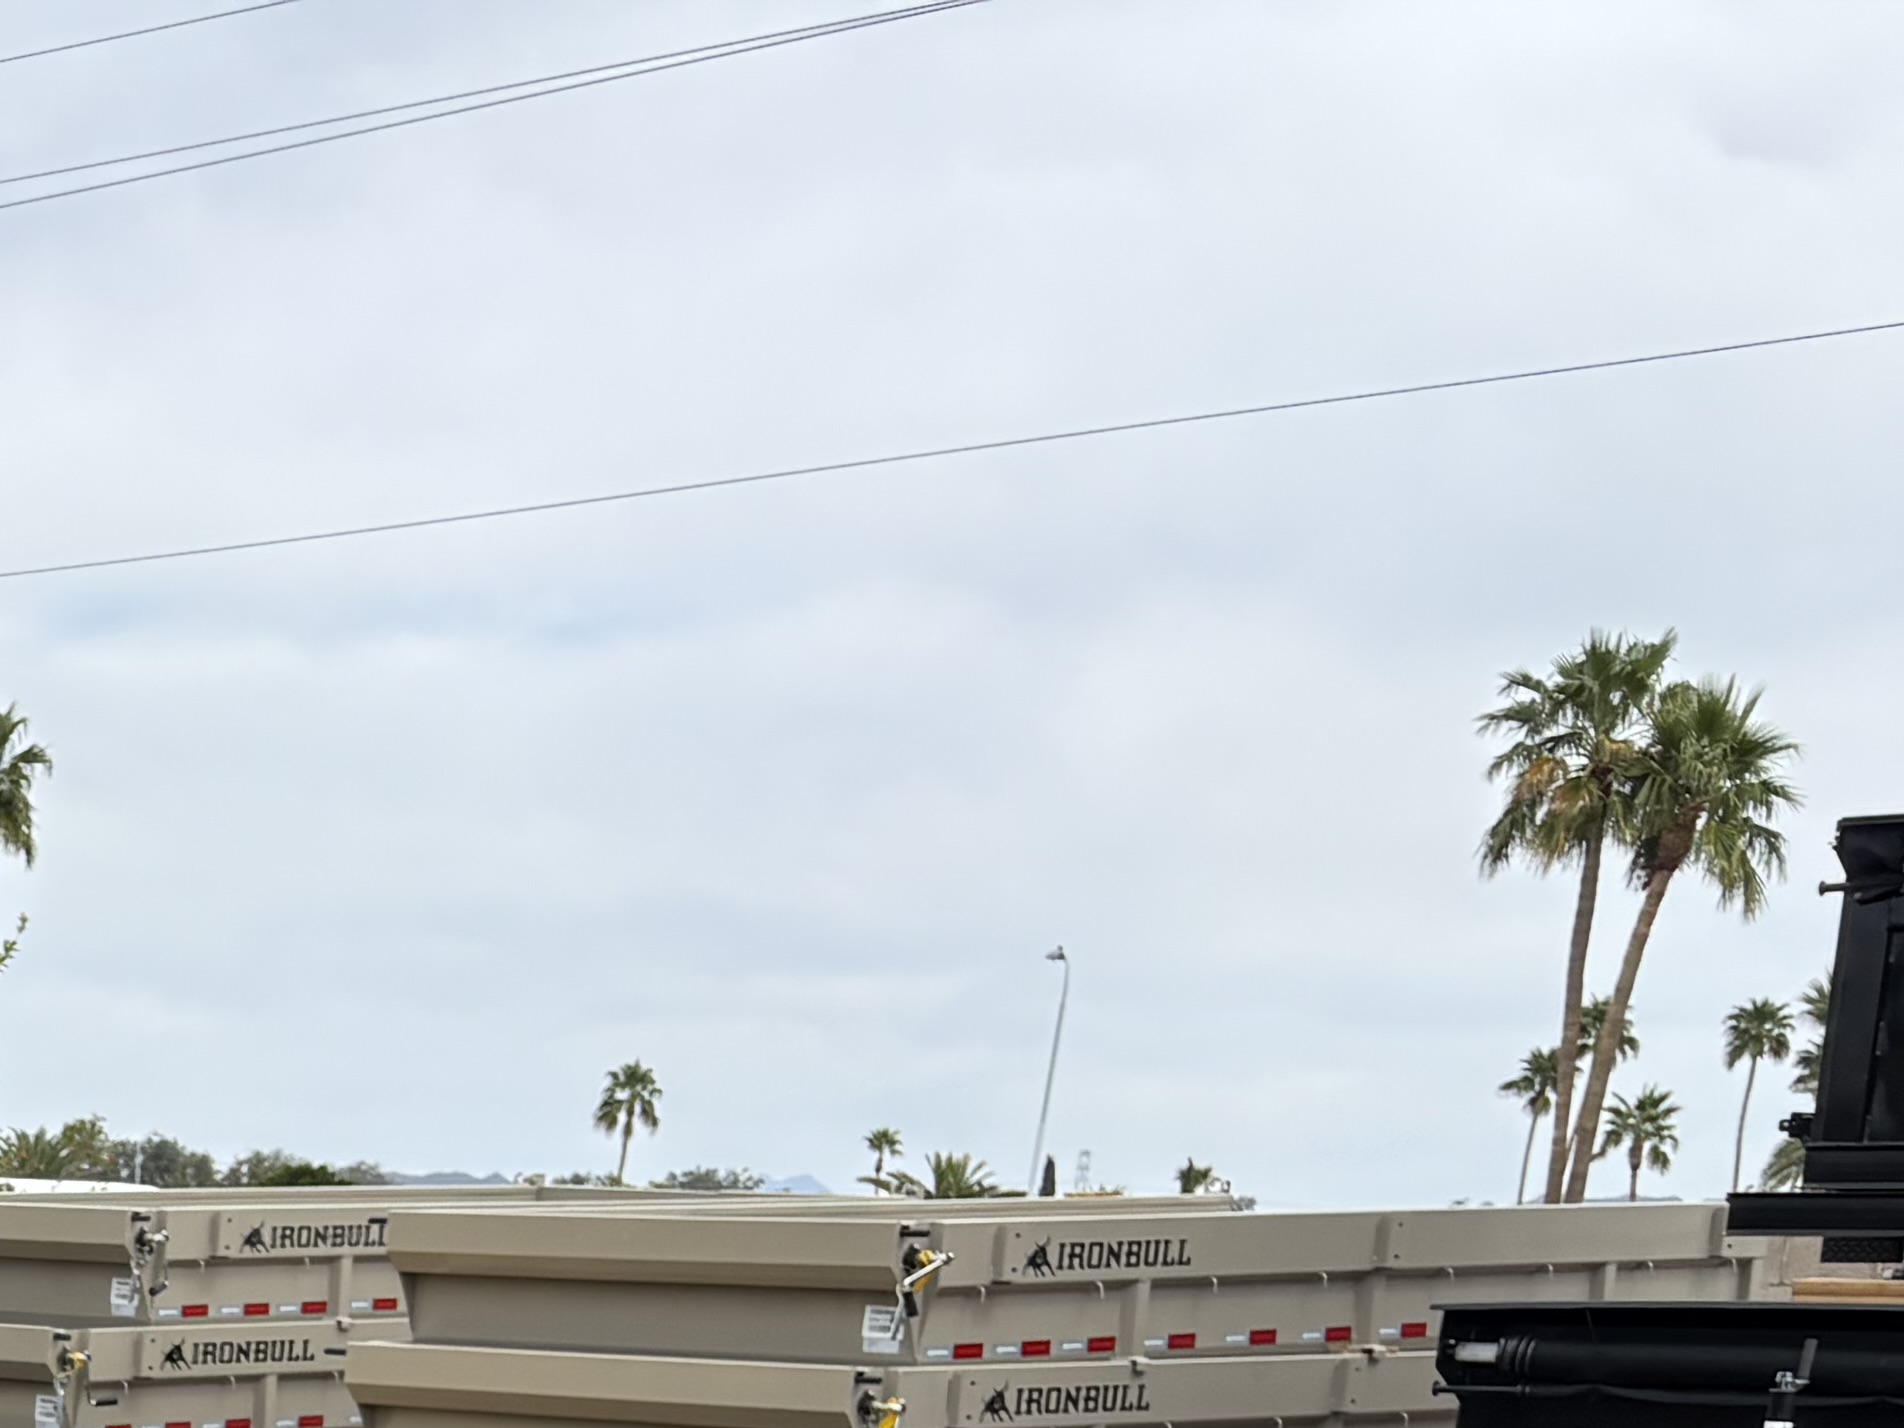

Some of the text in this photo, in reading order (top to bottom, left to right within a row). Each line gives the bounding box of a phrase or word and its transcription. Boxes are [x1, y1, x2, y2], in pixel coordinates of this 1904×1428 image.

[1056, 1239, 1191, 1271] IRONBULL
[192, 1339, 315, 1365] IRONBULL
[1014, 1383, 1150, 1416] IRONBULL
